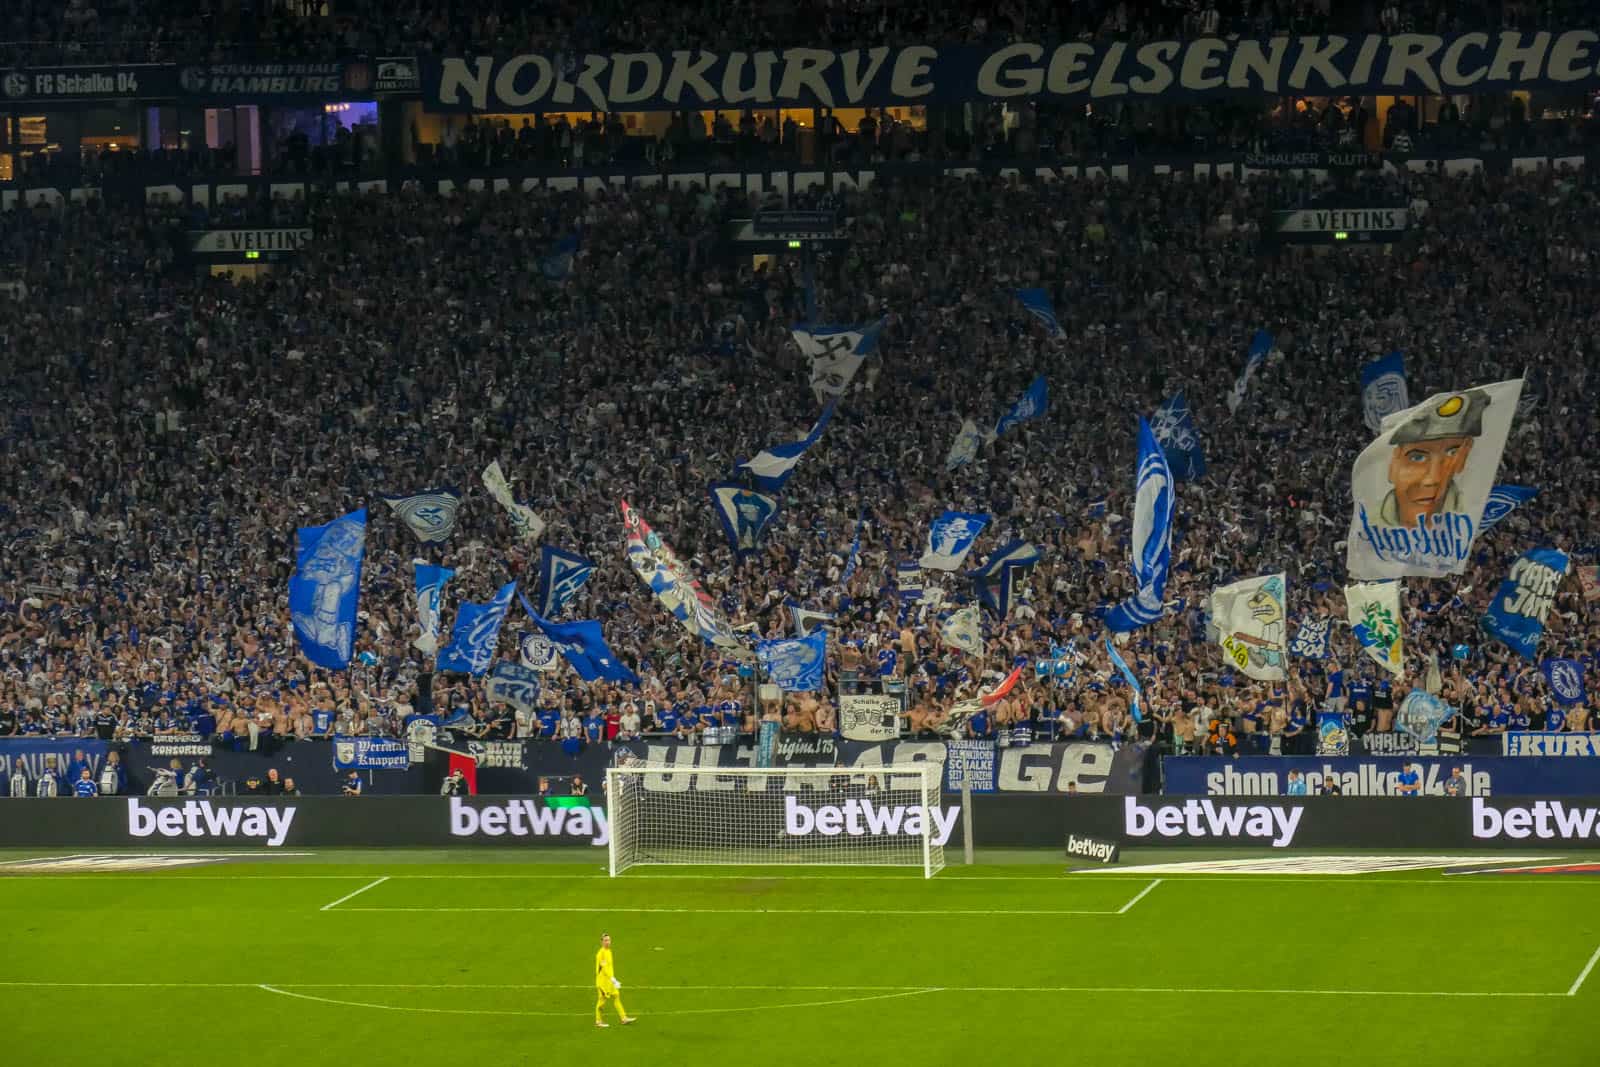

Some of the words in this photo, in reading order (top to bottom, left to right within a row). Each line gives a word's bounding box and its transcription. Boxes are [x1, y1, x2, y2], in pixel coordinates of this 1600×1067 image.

[117, 72, 138, 92] 04
[210, 76, 341, 93] HAMBURG
[438, 46, 938, 112] NORDKURVE
[976, 30, 1600, 98] GELSENKIRCHE
[1317, 211, 1395, 229] VELTINS
[359, 754, 406, 767] Knappen
[949, 750, 993, 760] GELSNKIRCHEN
[949, 760, 992, 770] SCALKE
[128, 798, 296, 846] betway
[450, 797, 609, 846] betway
[785, 796, 960, 846] betway
[1125, 797, 1304, 847] betway
[1472, 797, 1600, 839] betw
[1068, 834, 1115, 863] betway
